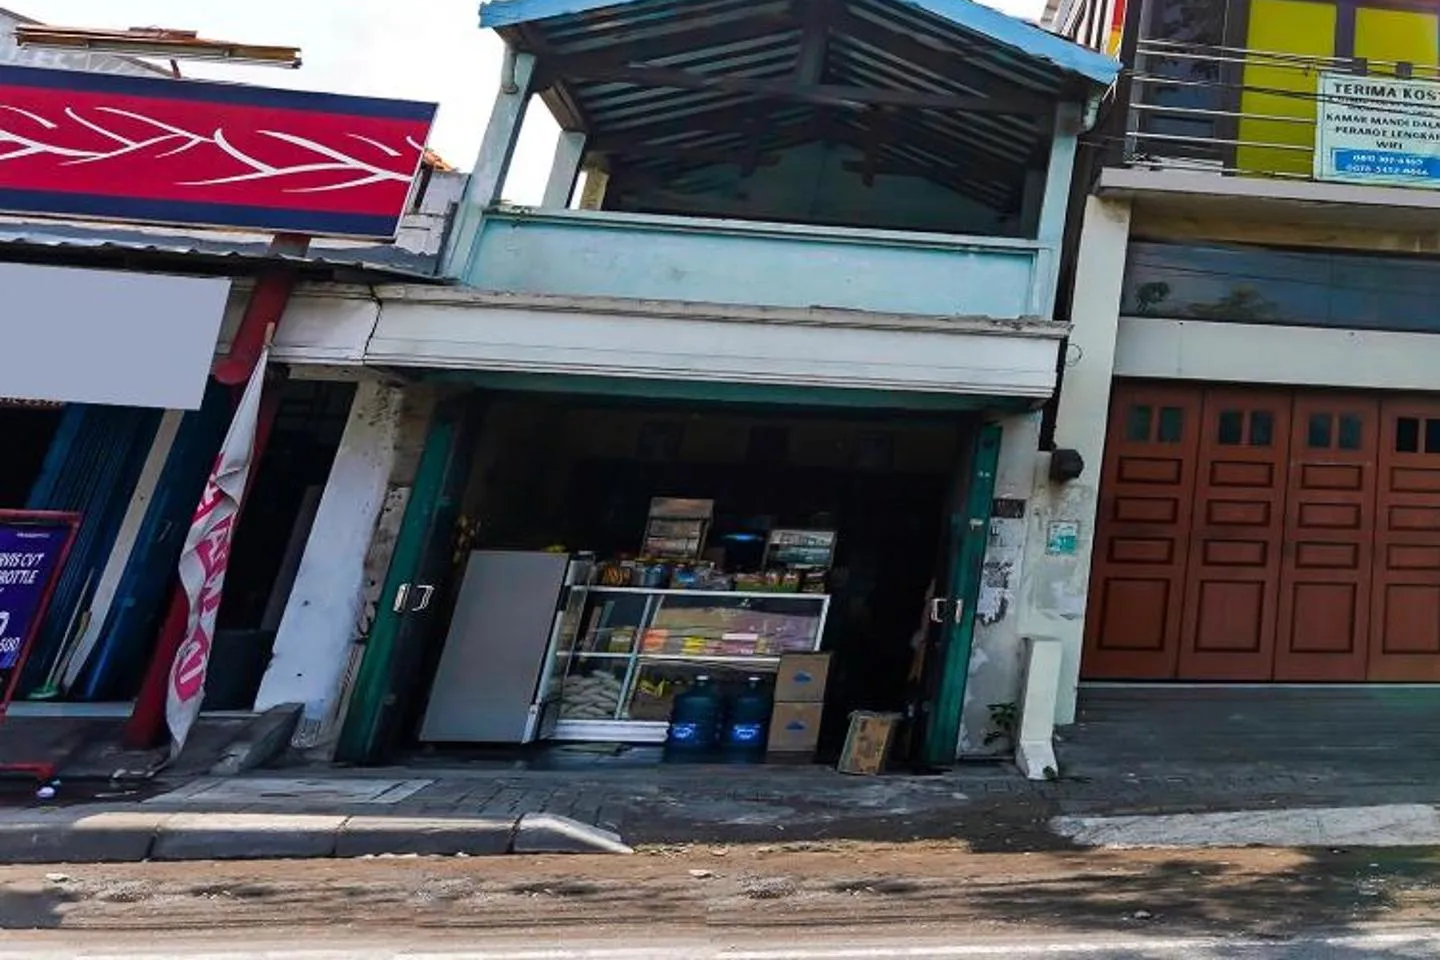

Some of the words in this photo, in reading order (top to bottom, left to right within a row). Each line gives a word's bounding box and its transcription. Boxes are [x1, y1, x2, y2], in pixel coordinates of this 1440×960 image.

[1333, 83, 1398, 99] TERIMA
[1326, 111, 1369, 125] KAMAR
[1370, 115, 1410, 128] MANDI
[1335, 125, 1387, 138] PERABOT
[21, 552, 45, 567] CVT
